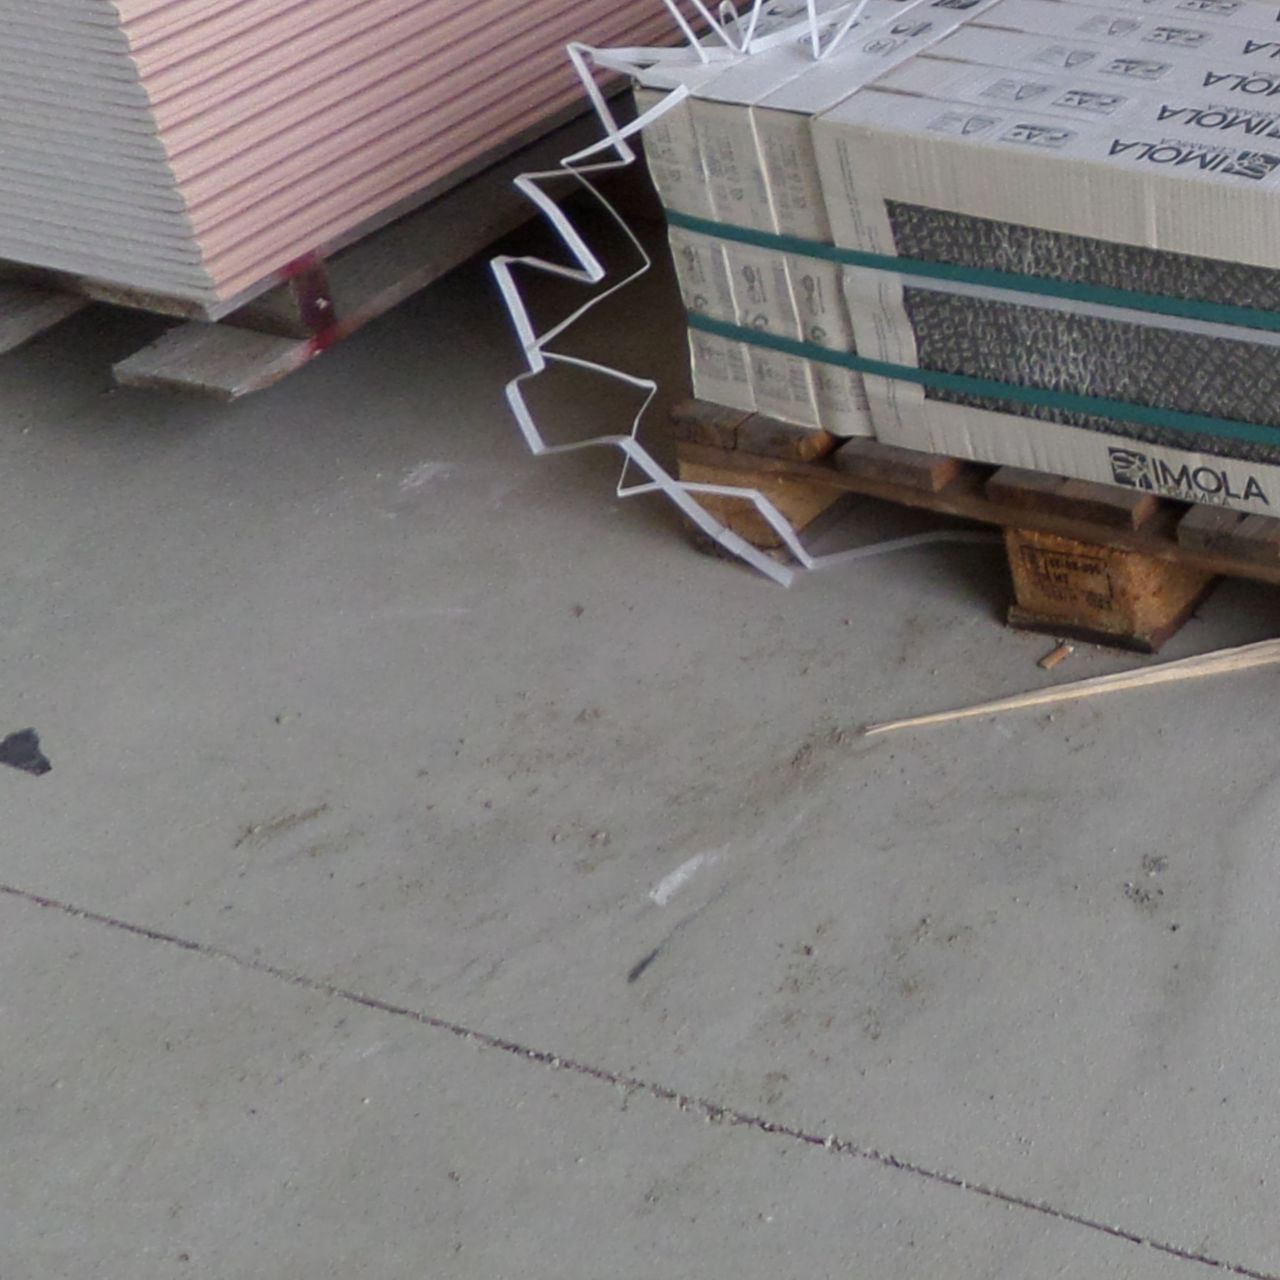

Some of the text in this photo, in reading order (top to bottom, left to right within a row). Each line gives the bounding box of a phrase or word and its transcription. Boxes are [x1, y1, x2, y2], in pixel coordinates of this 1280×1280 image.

[1157, 104, 1274, 135] IMOLA
[1109, 139, 1230, 171] IMOLA
[1151, 458, 1269, 506] IMOLA
